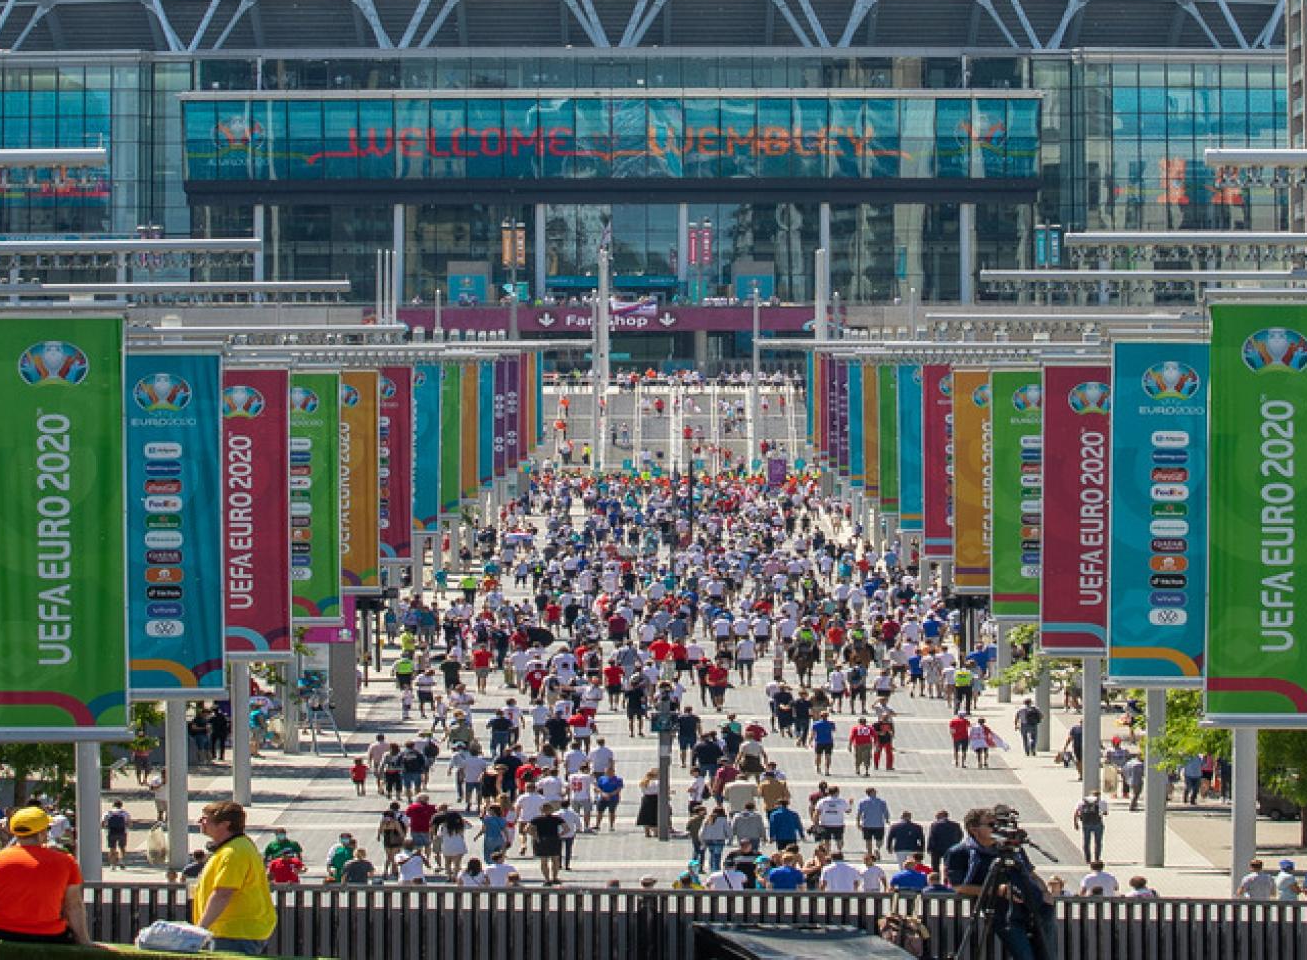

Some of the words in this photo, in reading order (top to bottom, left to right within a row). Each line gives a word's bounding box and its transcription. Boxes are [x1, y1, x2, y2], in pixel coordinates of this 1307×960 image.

[348, 127, 574, 157] WELCOME
[649, 126, 874, 157] WEMBLEY
[37, 496, 72, 579] EURO
[229, 491, 253, 550] EURO
[1080, 489, 1104, 545] EURO
[1260, 483, 1295, 565] EURO
[229, 552, 254, 609] UEFA
[1079, 550, 1104, 606] UEFA
[38, 582, 72, 665] UEFA
[1260, 571, 1294, 652] UEFA
